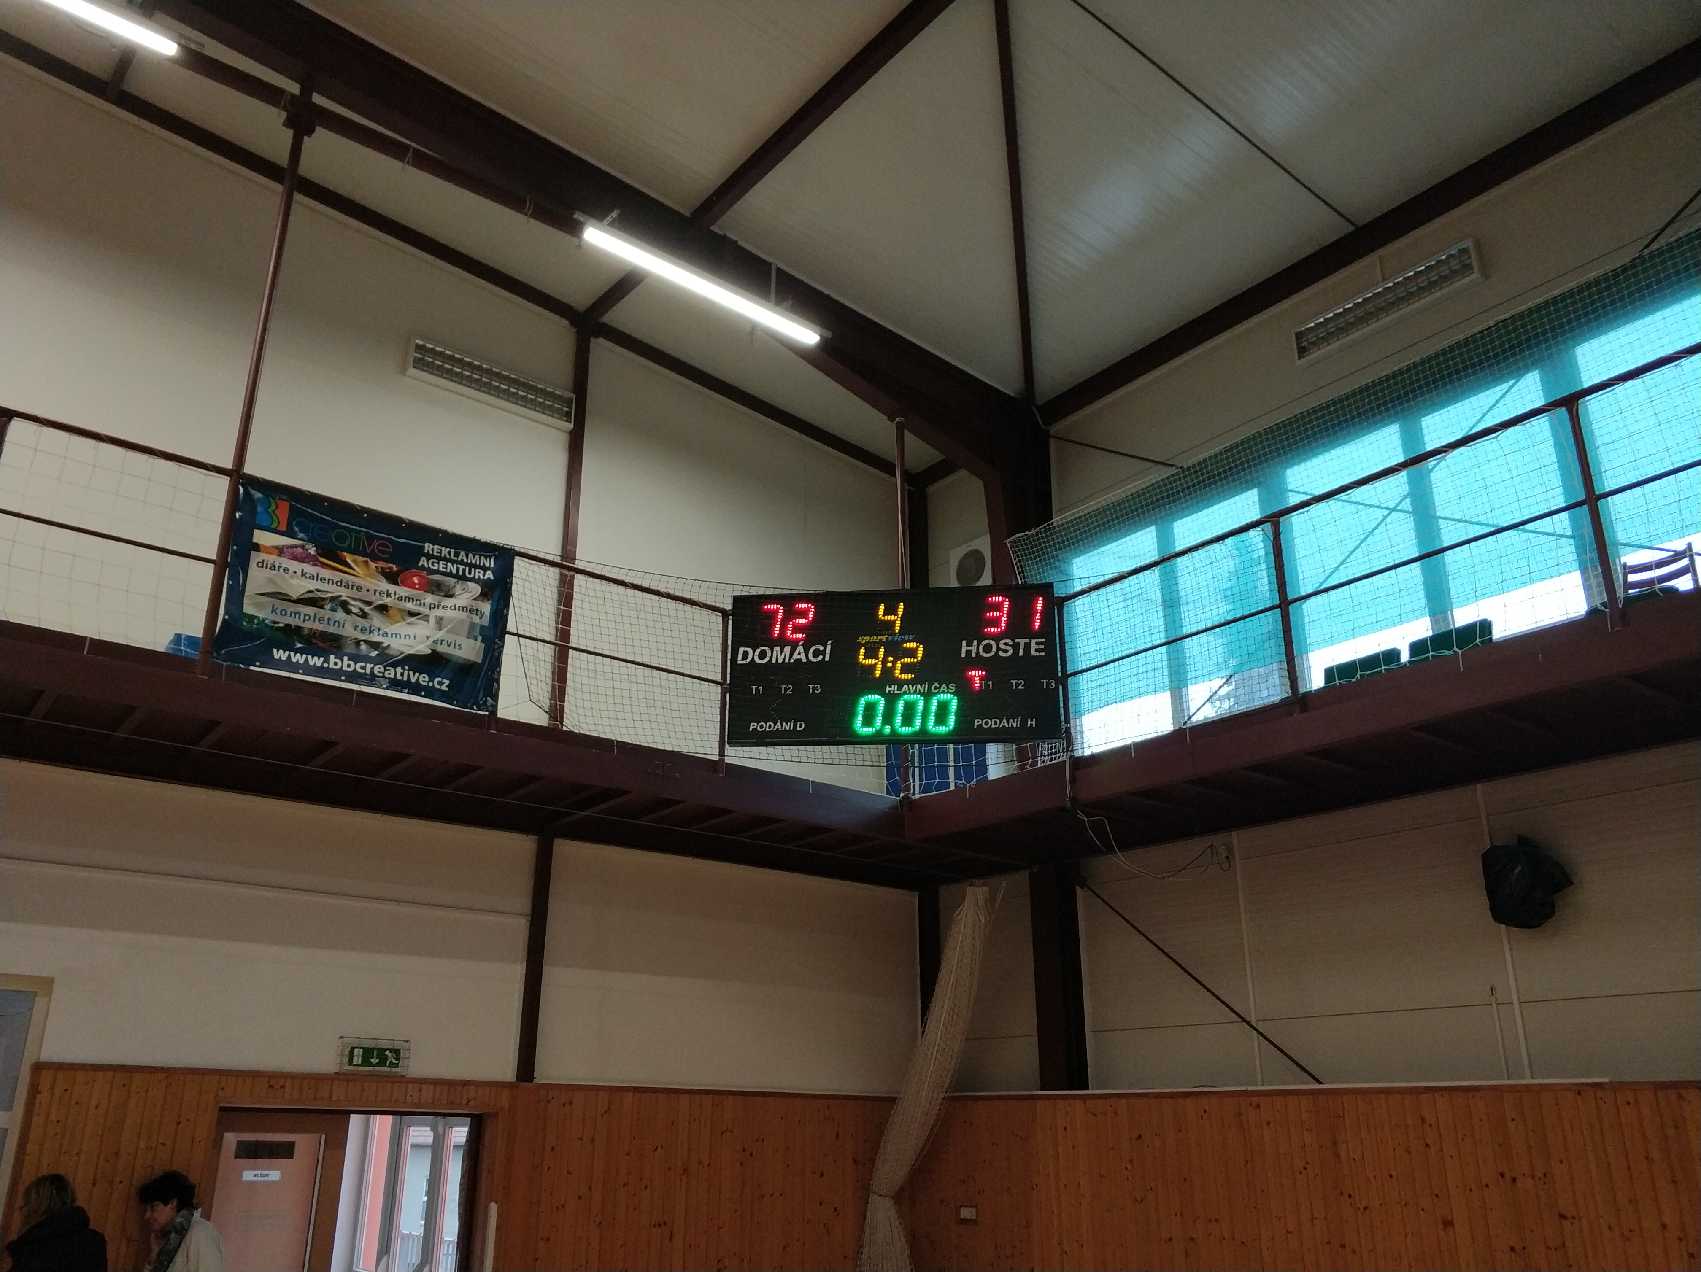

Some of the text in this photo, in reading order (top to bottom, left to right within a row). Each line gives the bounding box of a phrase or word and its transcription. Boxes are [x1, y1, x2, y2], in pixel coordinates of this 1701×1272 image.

[418, 556, 495, 580] AGENTURA
[763, 603, 816, 639] 72
[878, 602, 905, 633] 4
[984, 595, 1043, 633] 31
[736, 640, 834, 664] DOMÁCÍ
[960, 638, 1046, 658] HOSTE
[272, 648, 451, 691] www.bbcreative.cz
[858, 642, 924, 680] 4:2
[751, 684, 763, 695] T1
[781, 684, 793, 695] T2
[808, 684, 822, 694] T3
[885, 682, 956, 694] HLAVNÍ ČAS
[1010, 679, 1025, 690] T2
[1041, 679, 1056, 689] T3
[855, 693, 959, 736] 0.00
[974, 716, 1036, 728] PODÁNÍ H
[749, 720, 806, 732] PODÁNÍ D
